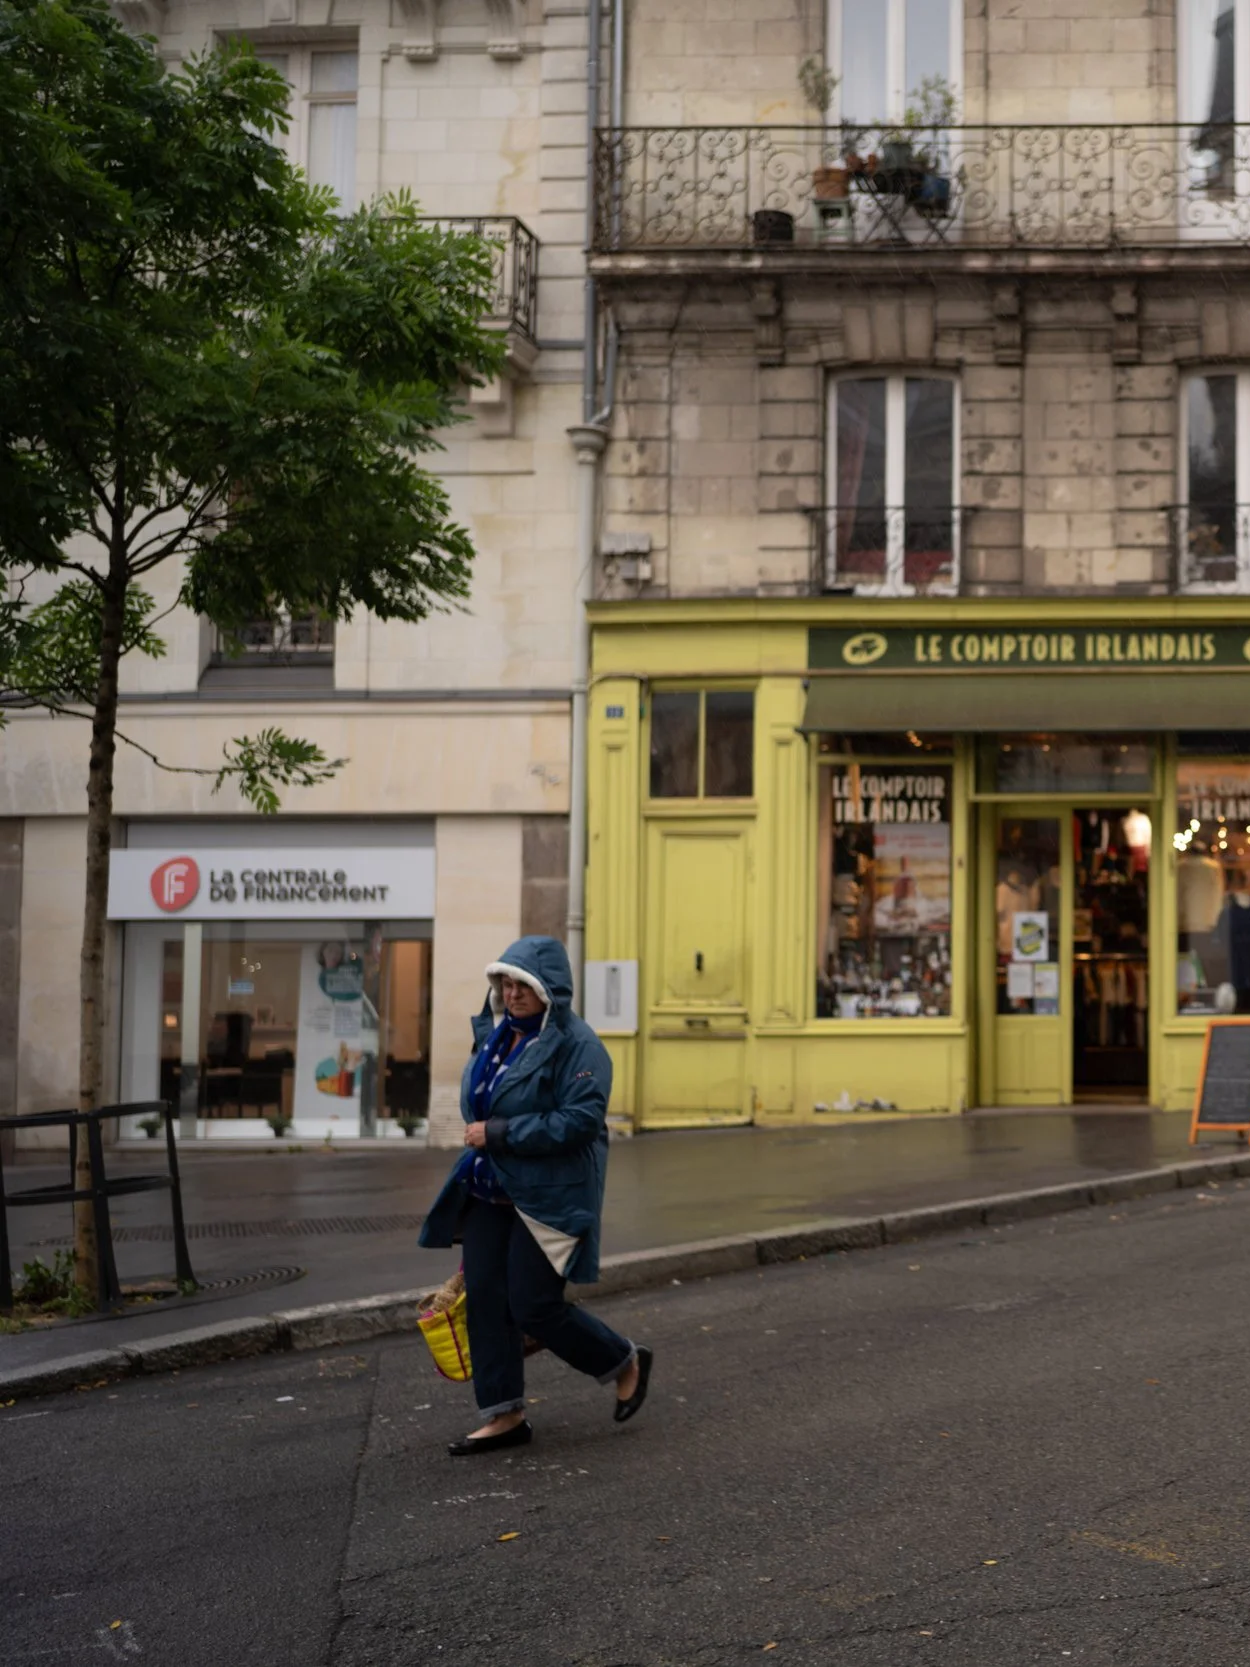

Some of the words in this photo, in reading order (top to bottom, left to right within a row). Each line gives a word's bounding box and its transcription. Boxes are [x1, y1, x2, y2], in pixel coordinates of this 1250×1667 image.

[914, 634, 943, 662] LE
[950, 634, 1076, 662] COMPTOIR
[1085, 633, 1217, 662] IRLANDAIS
[832, 775, 852, 798] LE
[860, 776, 945, 799] COMPTOIR
[835, 799, 942, 823] IRLANDAIS
